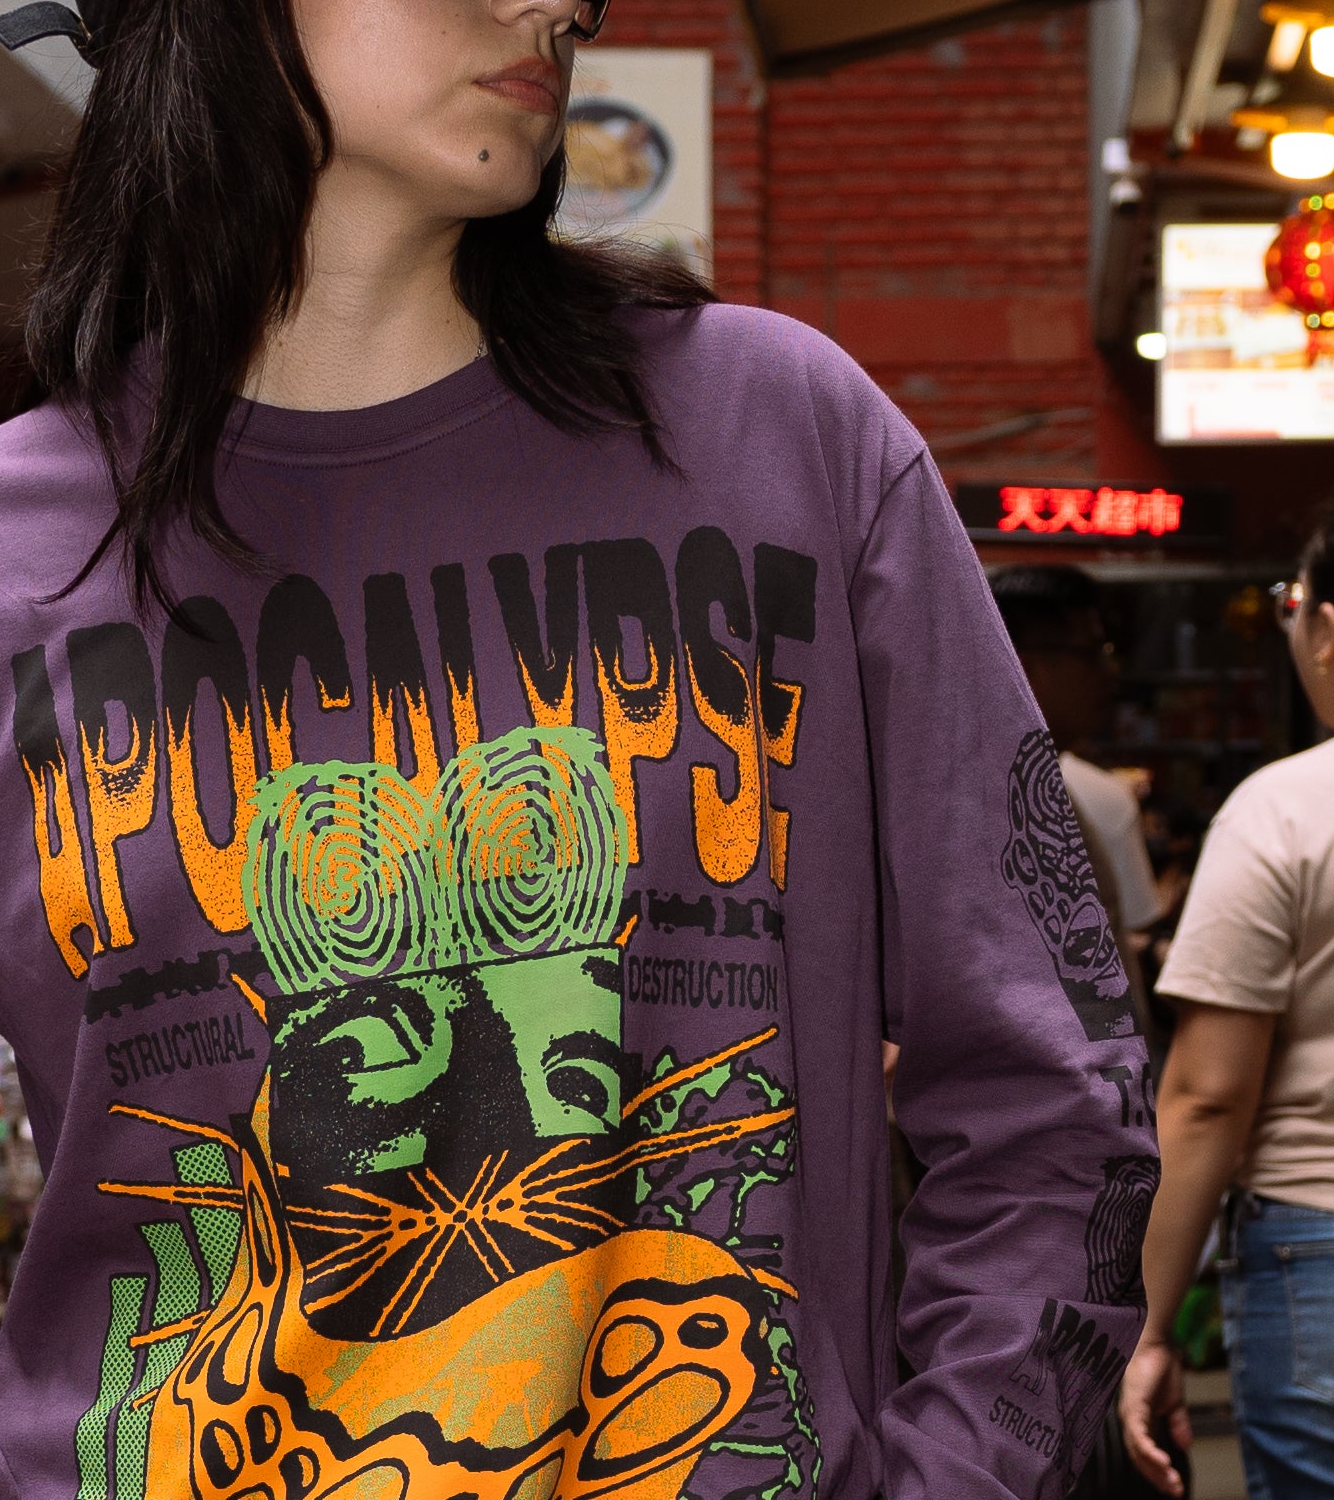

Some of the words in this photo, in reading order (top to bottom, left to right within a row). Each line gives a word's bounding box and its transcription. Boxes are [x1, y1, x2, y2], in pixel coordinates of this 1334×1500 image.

[11, 526, 818, 981] APOCALYPSE
[628, 954, 779, 1012] DESTRUCTION
[105, 1009, 256, 1088] STRUCTURAL
